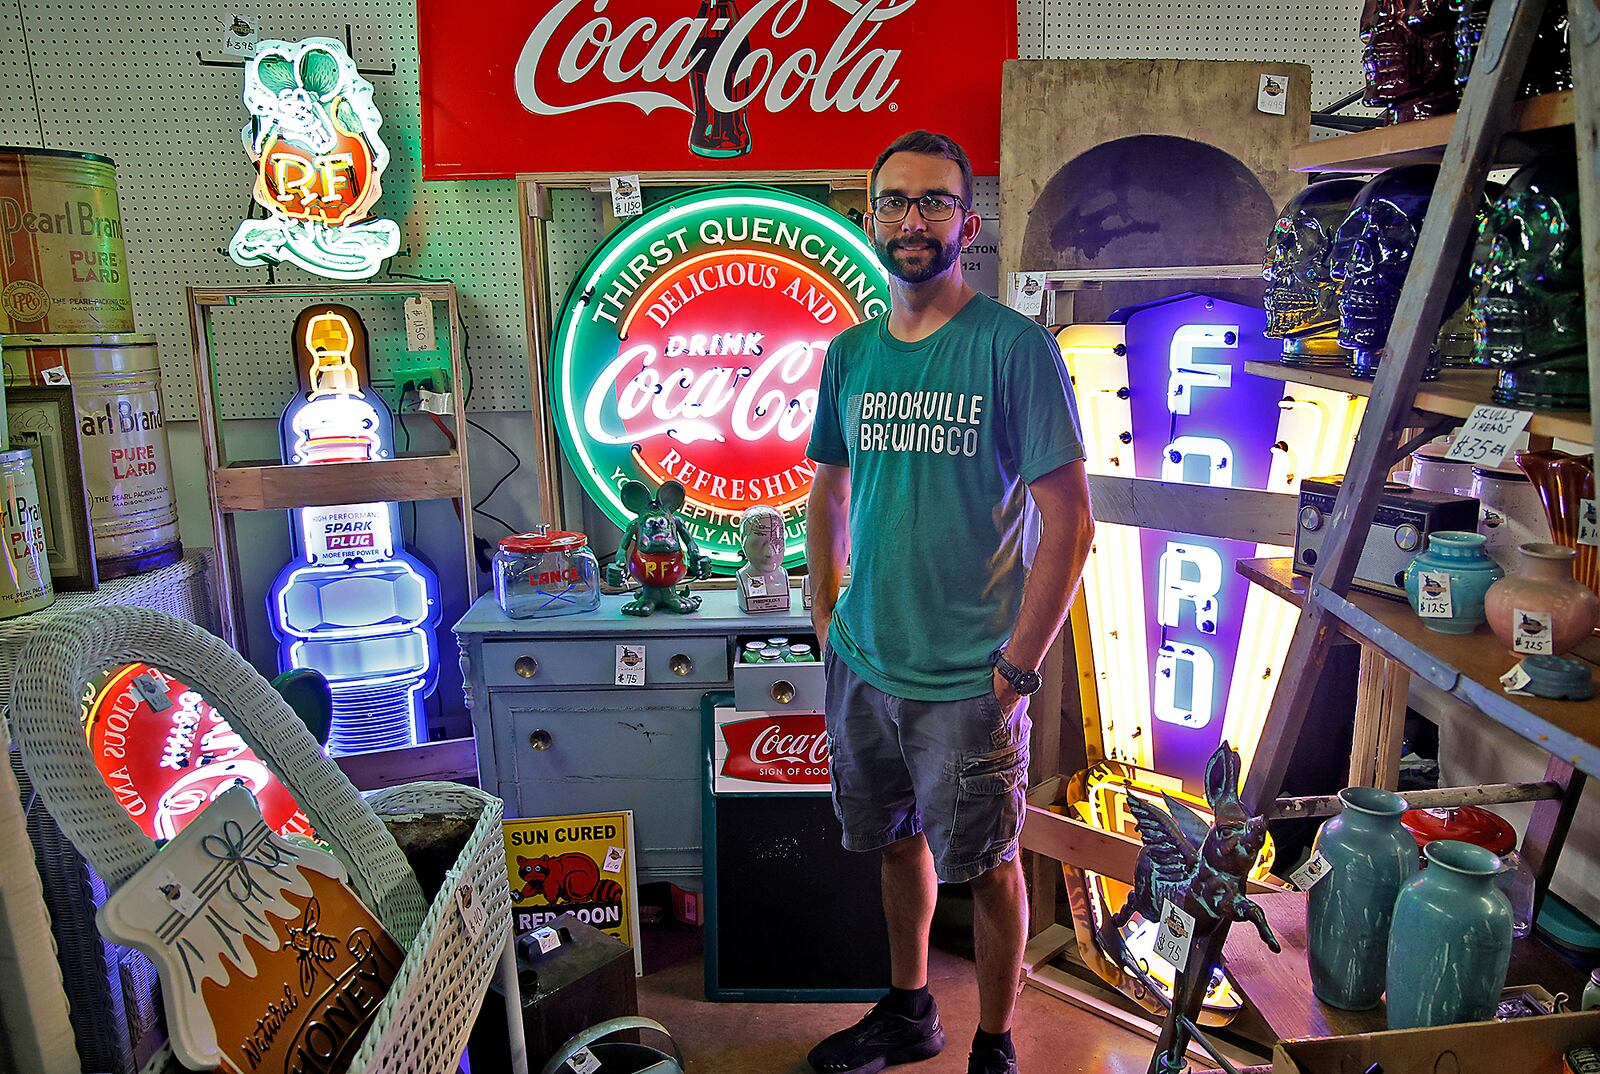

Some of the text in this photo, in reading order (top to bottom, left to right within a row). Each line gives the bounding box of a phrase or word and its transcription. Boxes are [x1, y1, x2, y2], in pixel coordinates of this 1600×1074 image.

[514, 0, 902, 115] Coca-Cola
[0, 196, 123, 267] Pearl Bran
[69, 250, 117, 267] PURE
[963, 262, 981, 270] 121
[72, 267, 120, 284] LARD
[592, 217, 888, 325] THIRST QUENCHING
[645, 261, 838, 328] DELICIOUS AND
[665, 332, 765, 358] DRINK
[584, 341, 829, 444] Coca-Co
[862, 391, 983, 425] BROOKVILLE
[79, 401, 163, 436] arl Brand
[111, 445, 155, 463] PURE
[113, 461, 157, 480] LARD
[658, 448, 818, 501] REFRESHIN
[111, 492, 133, 502] PEARL
[133, 488, 157, 498] PACKING
[16, 497, 41, 526] Bra
[329, 511, 380, 521] PERFORMAN
[325, 521, 372, 534] SPARK
[331, 534, 370, 548] PLUG
[718, 530, 743, 546] AN
[322, 549, 380, 559] MORE FIRE POWER
[645, 561, 670, 579] RF
[2, 593, 14, 601] THE
[750, 725, 831, 764] Coca-C
[759, 767, 829, 776] SIGN OF GOO
[511, 824, 616, 847] SUN CURED
[566, 905, 619, 925] OON
[1157, 932, 1182, 961] $95
[242, 982, 298, 1070] Natural
